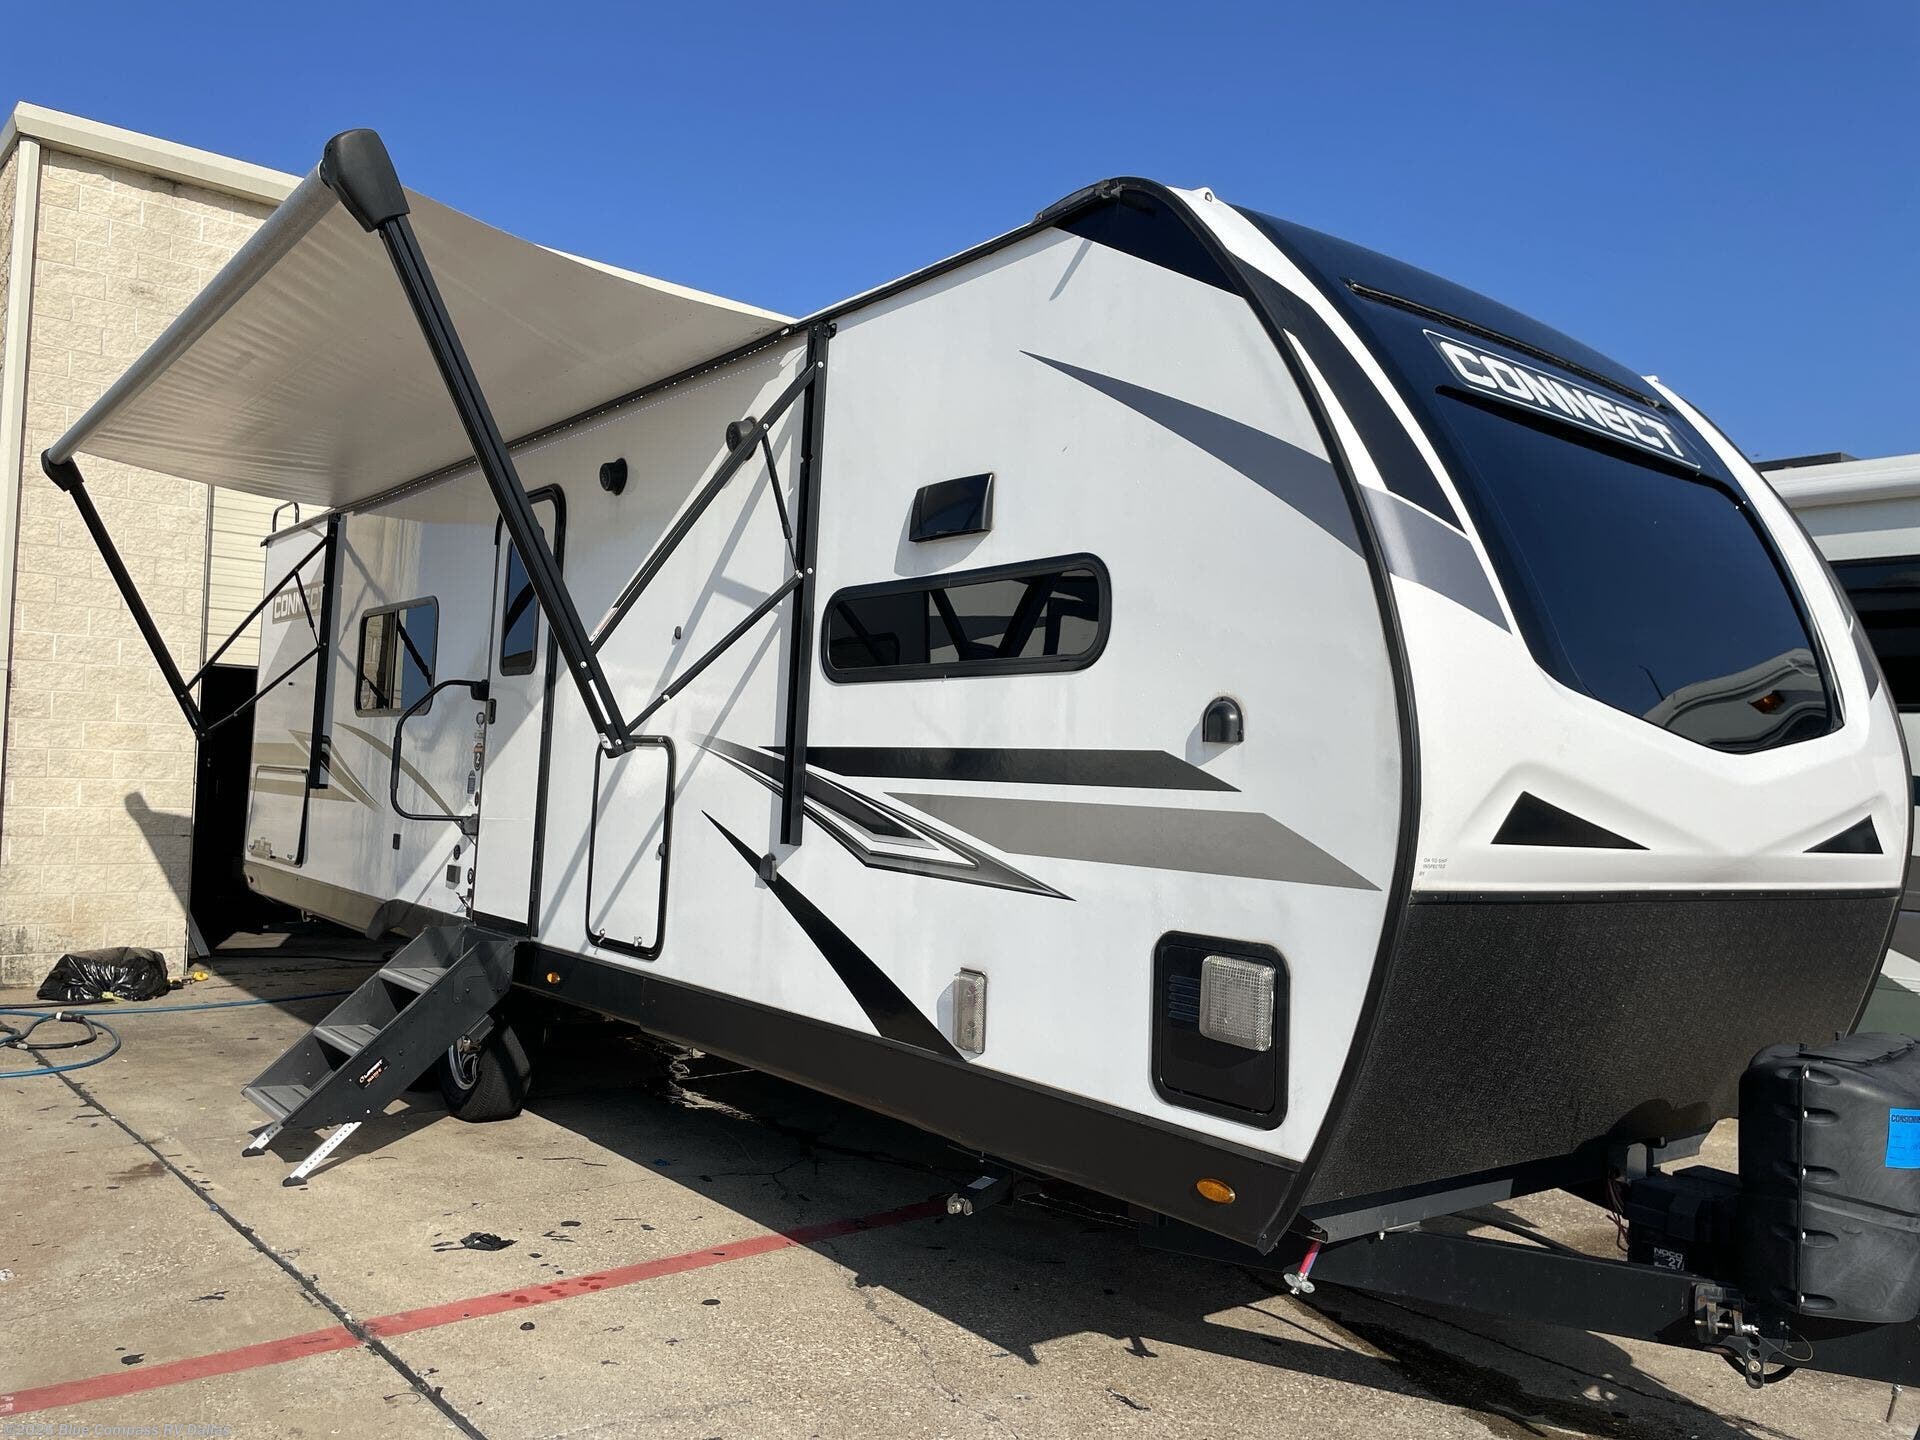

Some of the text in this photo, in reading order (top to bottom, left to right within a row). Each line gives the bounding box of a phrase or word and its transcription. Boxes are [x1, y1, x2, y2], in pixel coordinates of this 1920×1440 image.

[1440, 341, 1684, 457] CONNECT
[274, 586, 323, 619] CONNC
[1653, 1246, 1684, 1260] NOCO
[1668, 1257, 1683, 1269] 27
